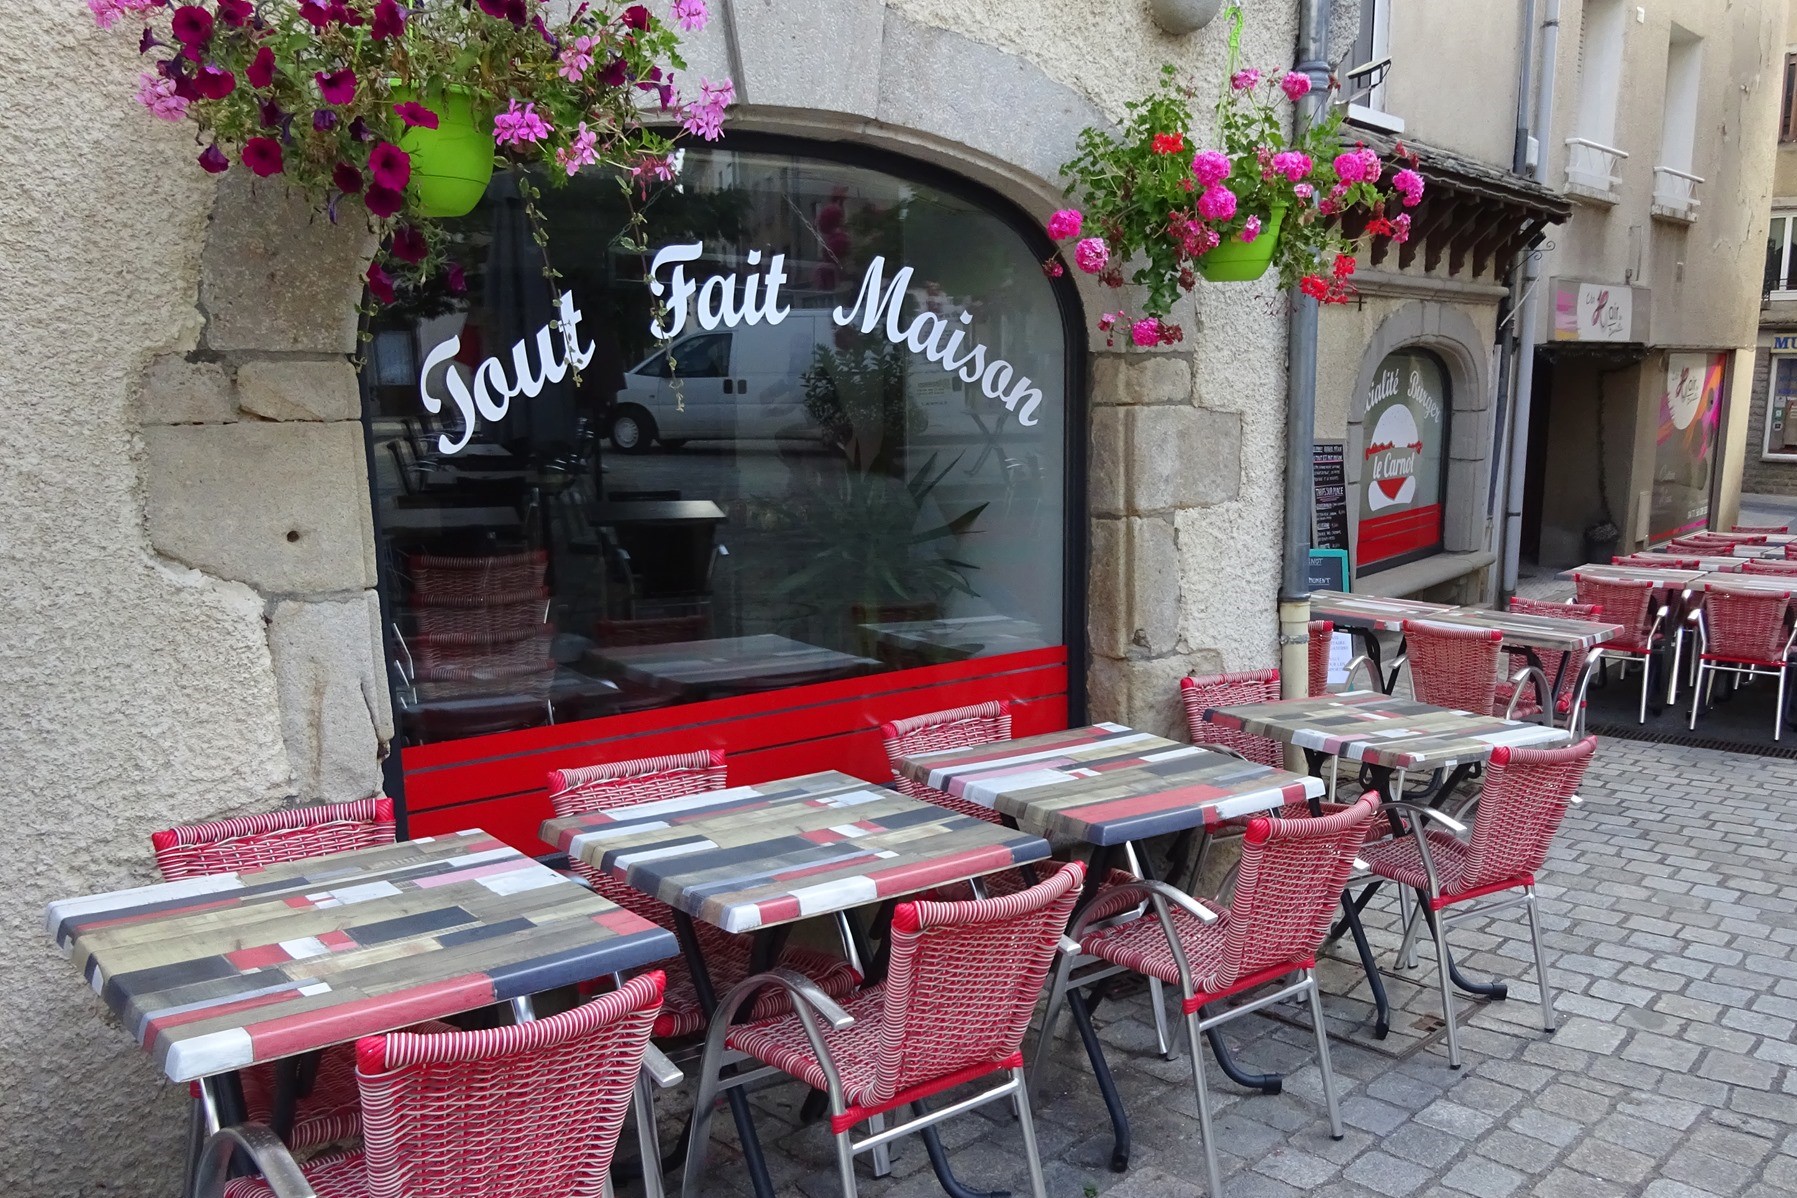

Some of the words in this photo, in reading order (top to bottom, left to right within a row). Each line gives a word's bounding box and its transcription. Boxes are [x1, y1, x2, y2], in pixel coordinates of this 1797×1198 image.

[420, 289, 596, 455] Tout
[650, 240, 791, 341] Fait
[833, 255, 1044, 427] Maison
[1364, 368, 1400, 414] cialité
[1407, 370, 1441, 423] Burger
[1373, 455, 1383, 480] le
[1384, 451, 1415, 478] Carnot
